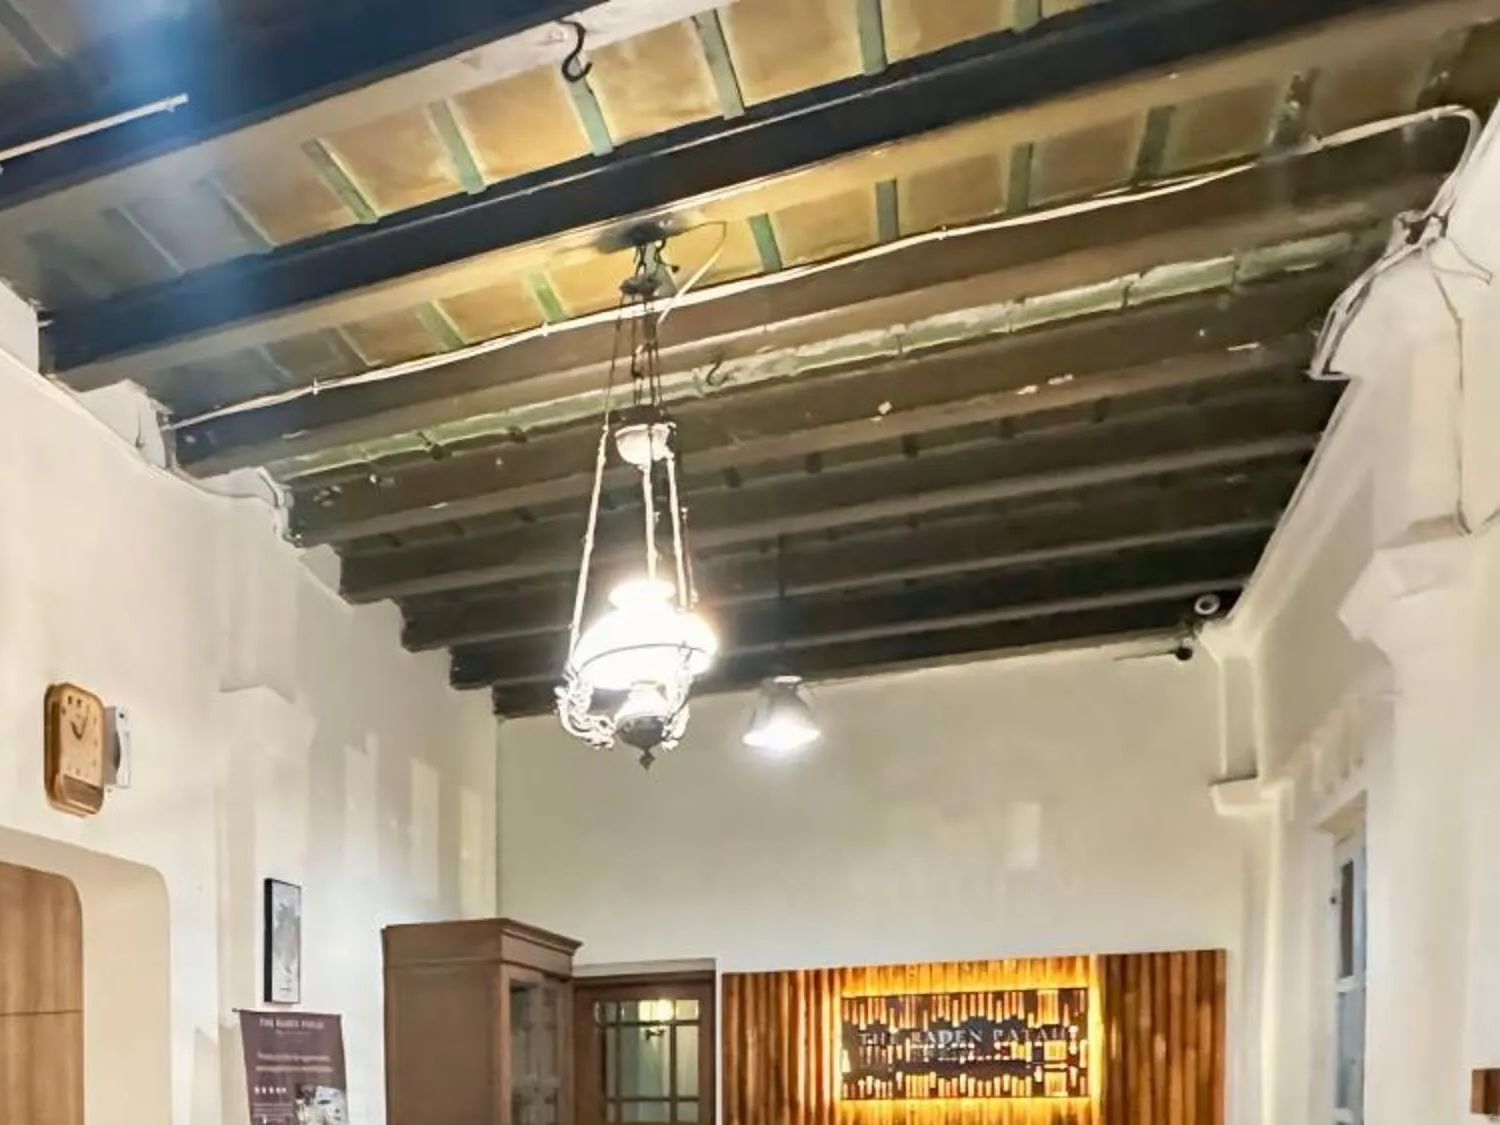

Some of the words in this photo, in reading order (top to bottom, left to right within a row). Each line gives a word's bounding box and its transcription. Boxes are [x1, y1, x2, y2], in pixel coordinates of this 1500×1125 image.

[857, 1032, 897, 1046] THE
[910, 1028, 983, 1045] RADEN
[992, 1026, 1068, 1042] PATAH
